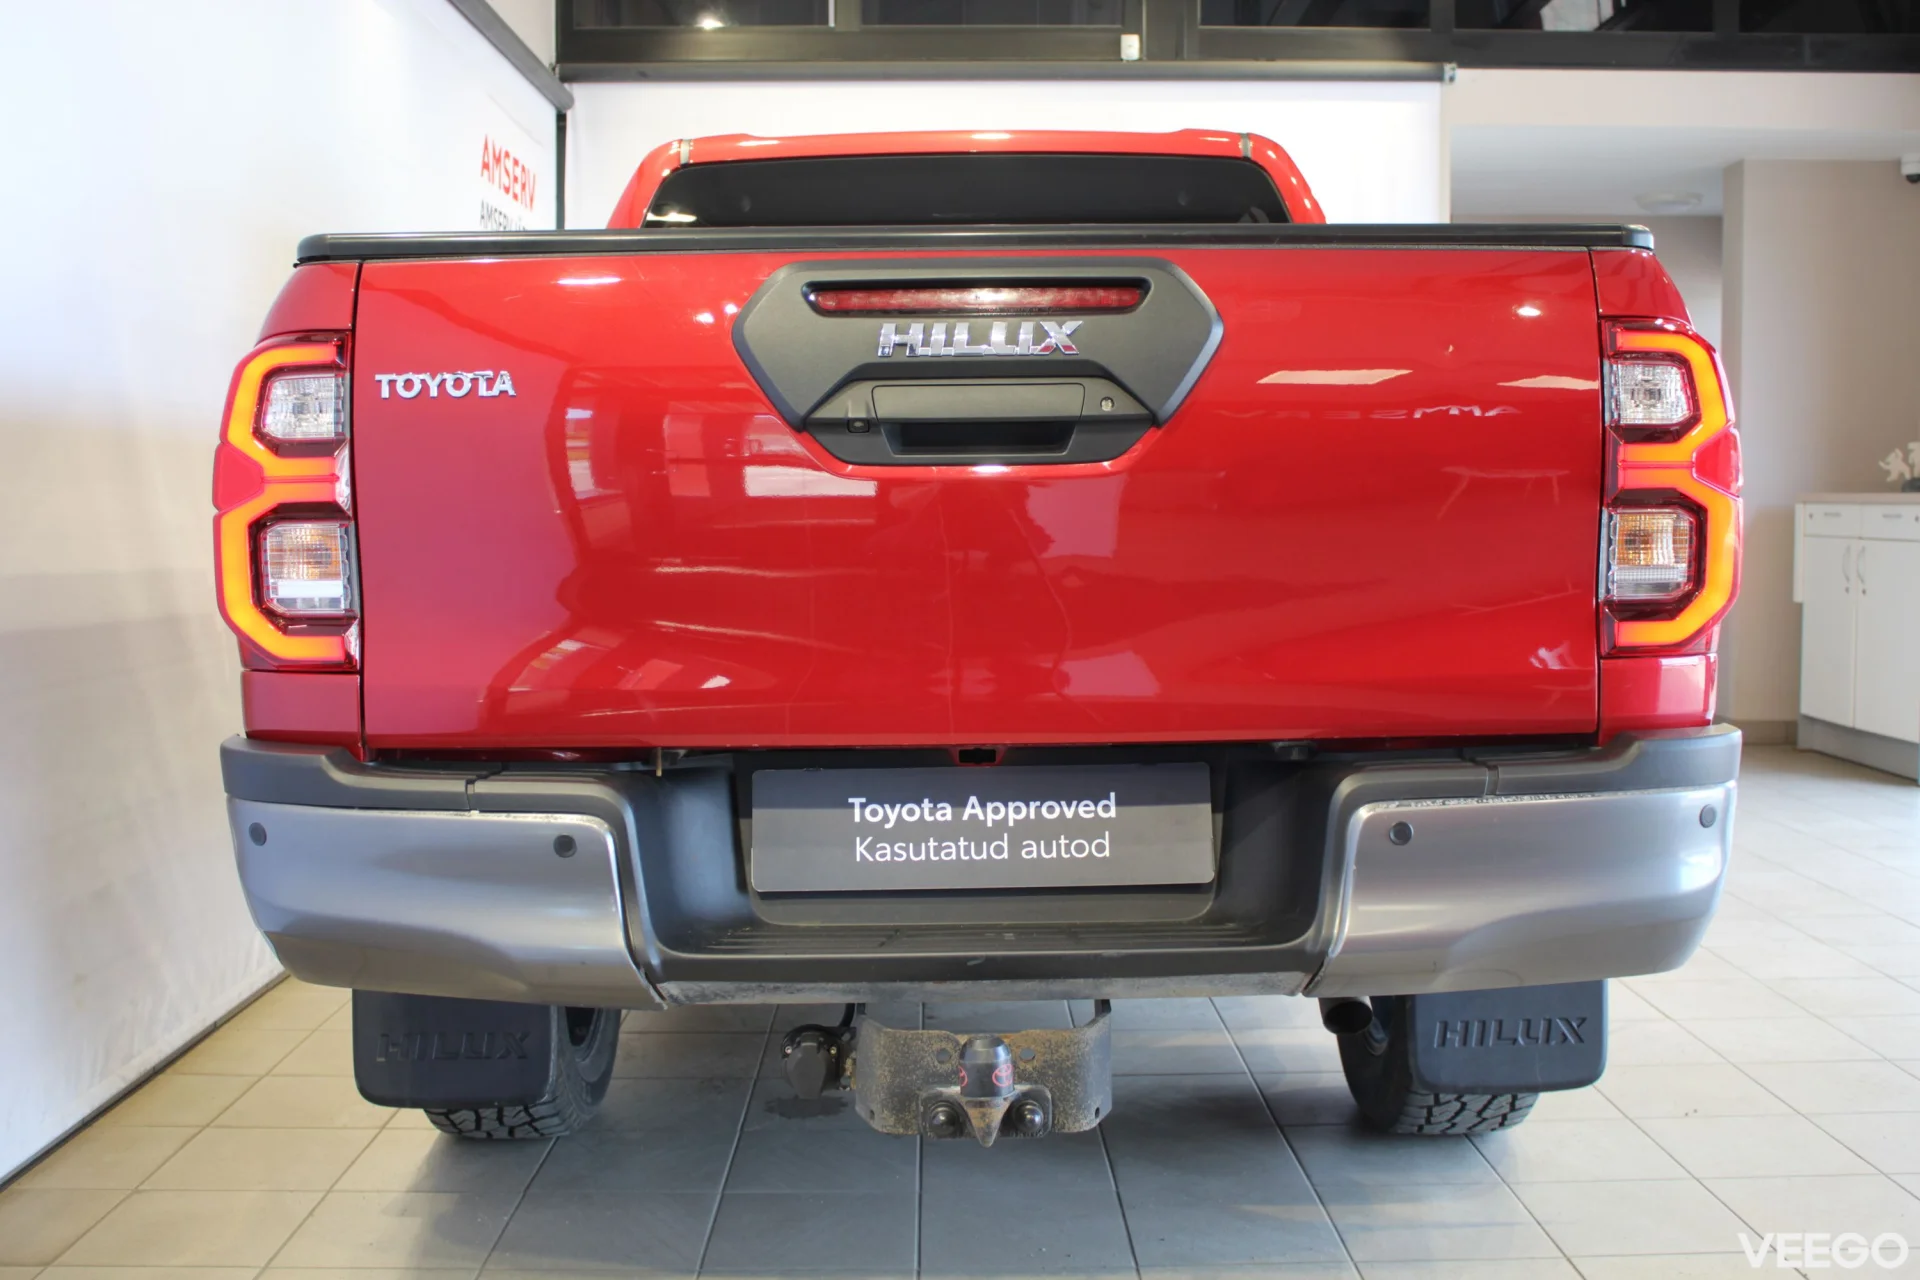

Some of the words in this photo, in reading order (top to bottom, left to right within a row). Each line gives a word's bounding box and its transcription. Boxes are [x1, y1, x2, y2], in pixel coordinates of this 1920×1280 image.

[480, 133, 536, 213] AMSERV
[877, 321, 1084, 357] HILUX
[375, 371, 517, 399] TOYOTA
[848, 797, 953, 829] Toyota
[962, 792, 1117, 827] Approved
[855, 833, 1009, 862] Kasutatud
[1021, 831, 1111, 859] autod
[376, 1031, 532, 1062] HILUX
[1434, 1016, 1588, 1049] HILUX
